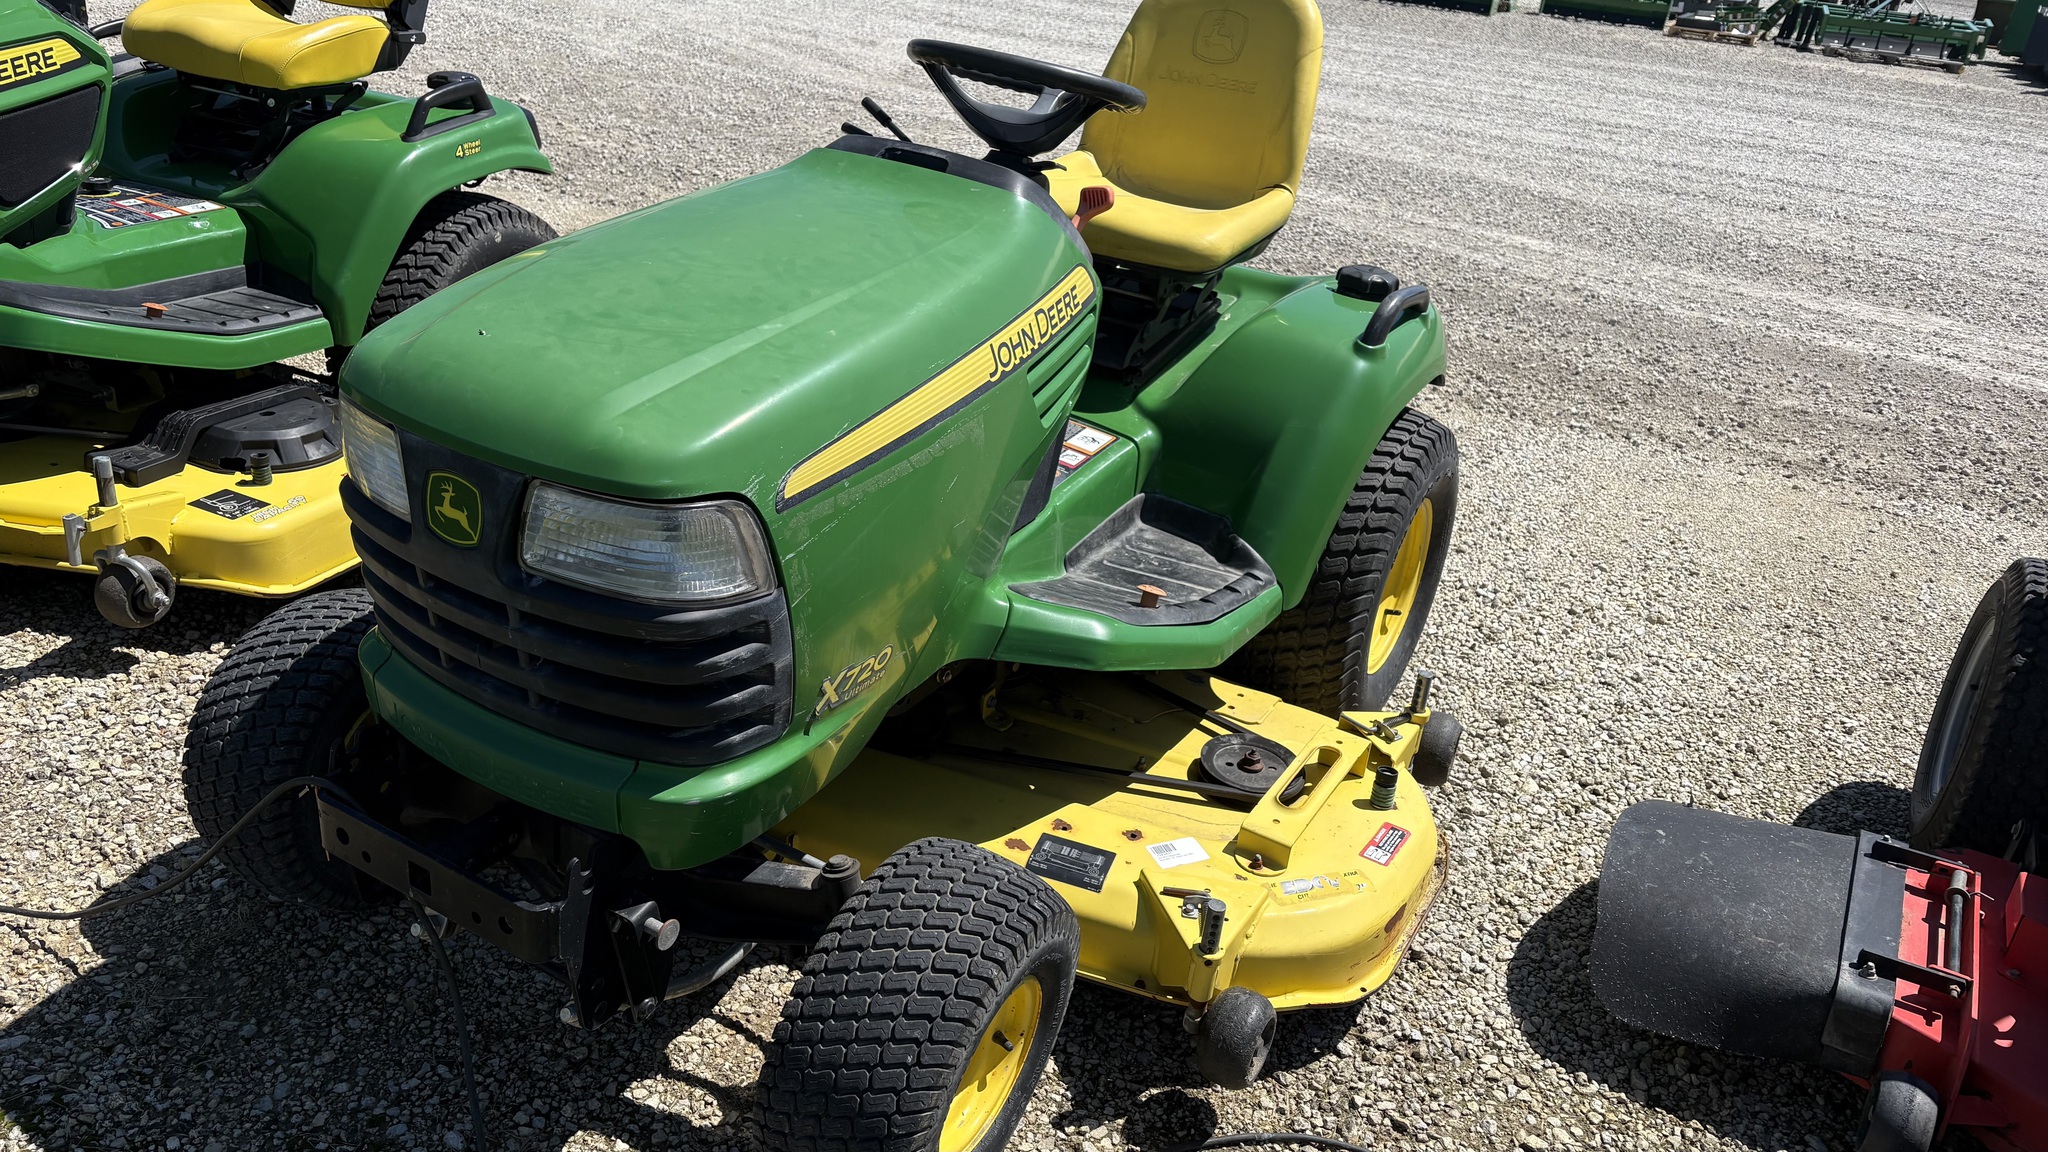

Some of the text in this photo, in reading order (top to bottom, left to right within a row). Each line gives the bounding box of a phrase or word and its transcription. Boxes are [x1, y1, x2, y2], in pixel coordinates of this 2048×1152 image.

[1158, 65, 1258, 95] JOHN DEERE
[455, 139, 481, 158] 4 Wheel
[989, 284, 1080, 380] JOHN DEERE
[814, 644, 894, 718] X720
